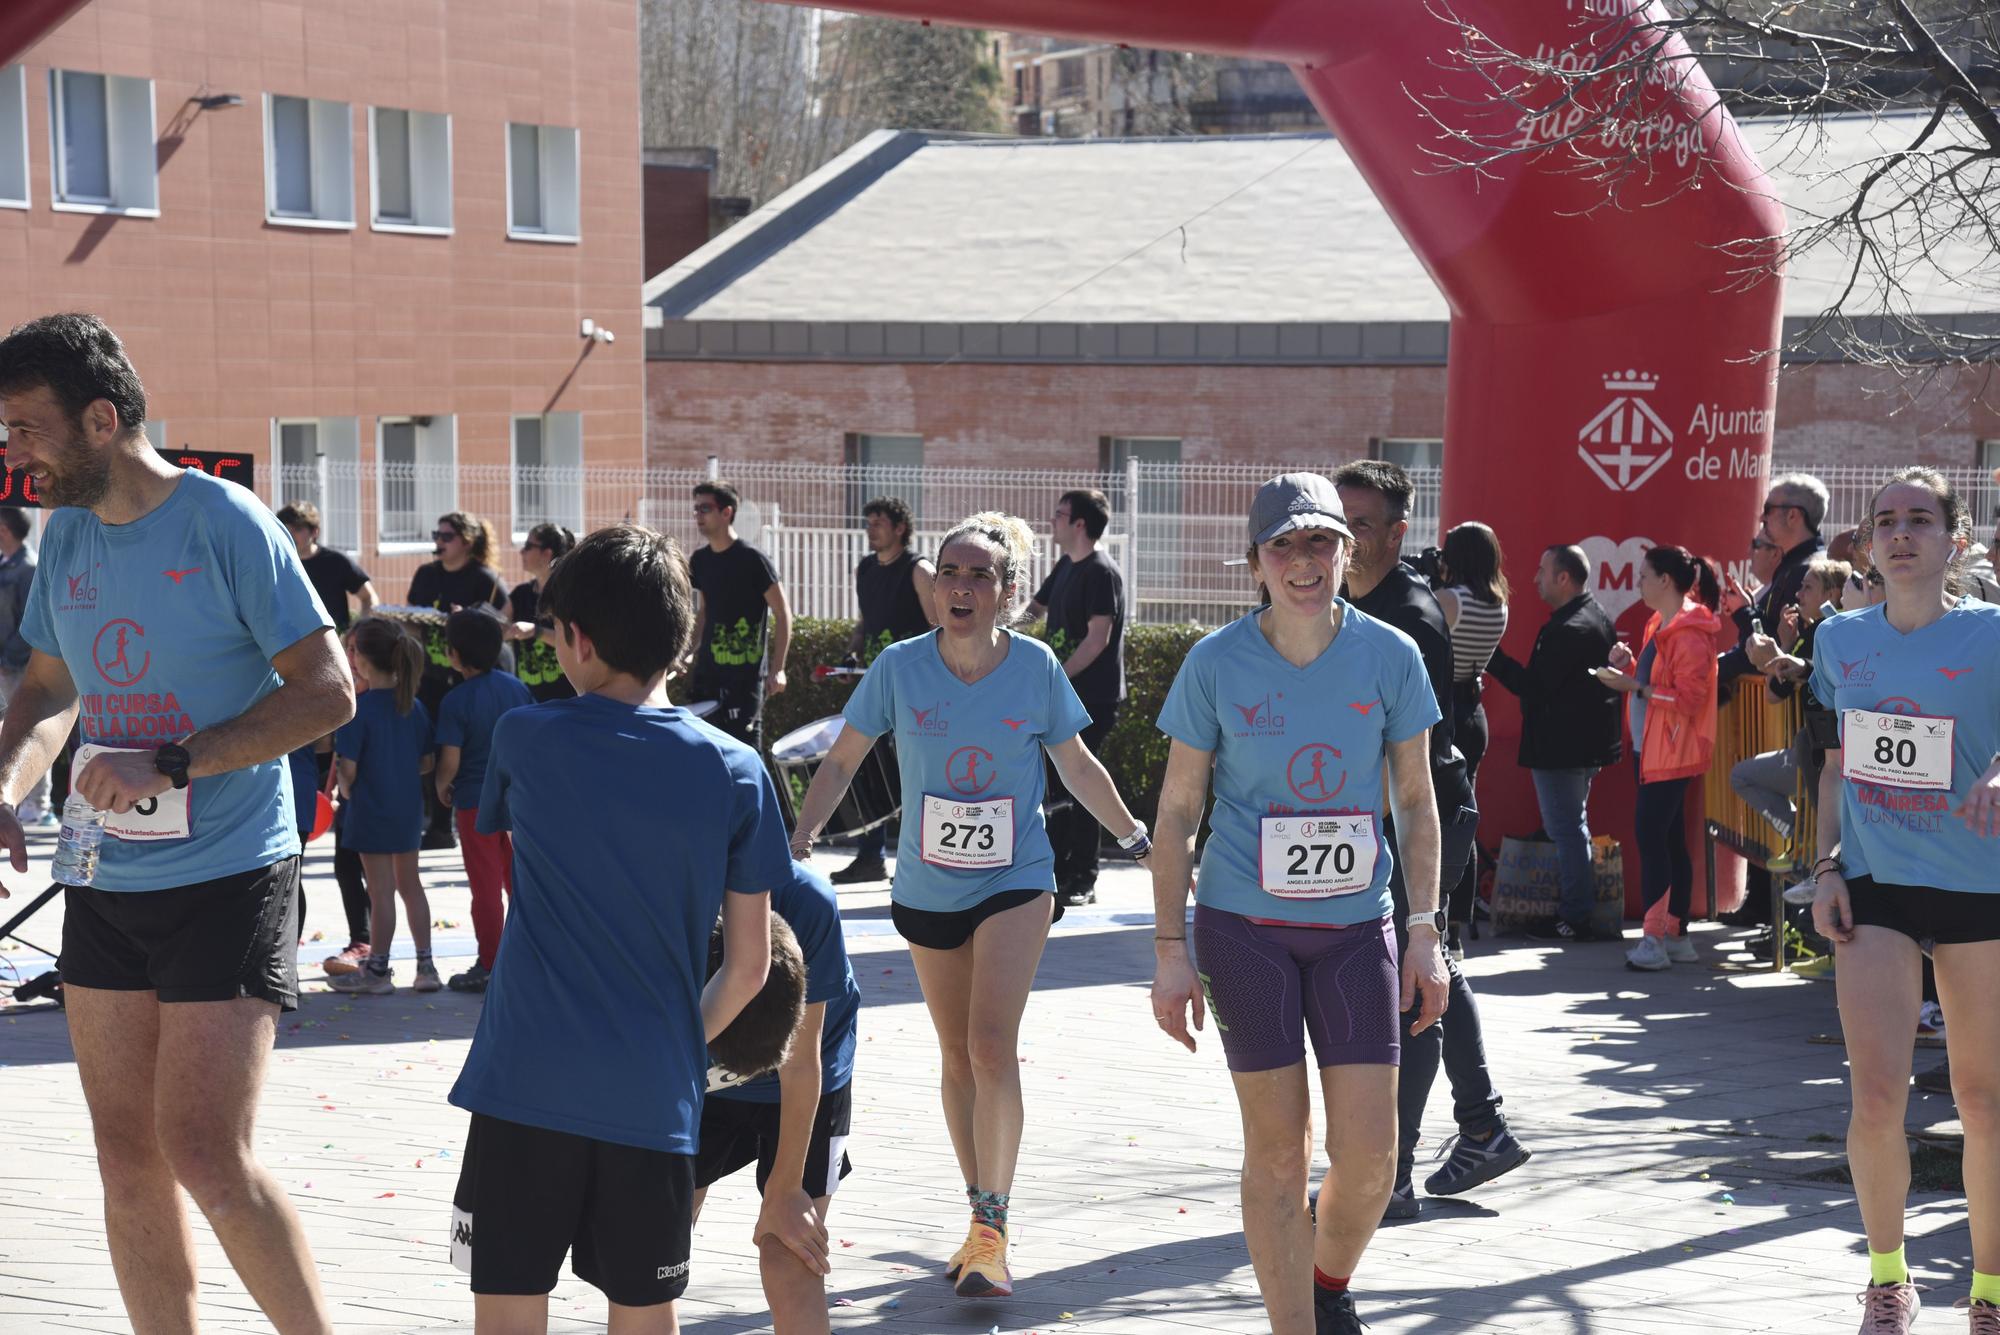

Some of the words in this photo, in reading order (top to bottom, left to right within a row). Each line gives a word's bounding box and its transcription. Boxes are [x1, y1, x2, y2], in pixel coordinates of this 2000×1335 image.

[1684, 447, 1721, 480] de
[1287, 503, 1321, 512] adidas
[1598, 561, 1633, 591] M
[1837, 652, 1877, 681] Vela
[106, 693, 181, 714] CURSA
[906, 700, 949, 730] Vela
[1232, 692, 1285, 729] Vela
[98, 716, 122, 738] LA
[127, 713, 195, 737] DONA
[1874, 736, 1917, 768] 80
[1858, 789, 1950, 813] MANRESA
[1862, 808, 1944, 831] JUNYENT
[940, 822, 994, 851] 273
[1287, 843, 1355, 876] 270
